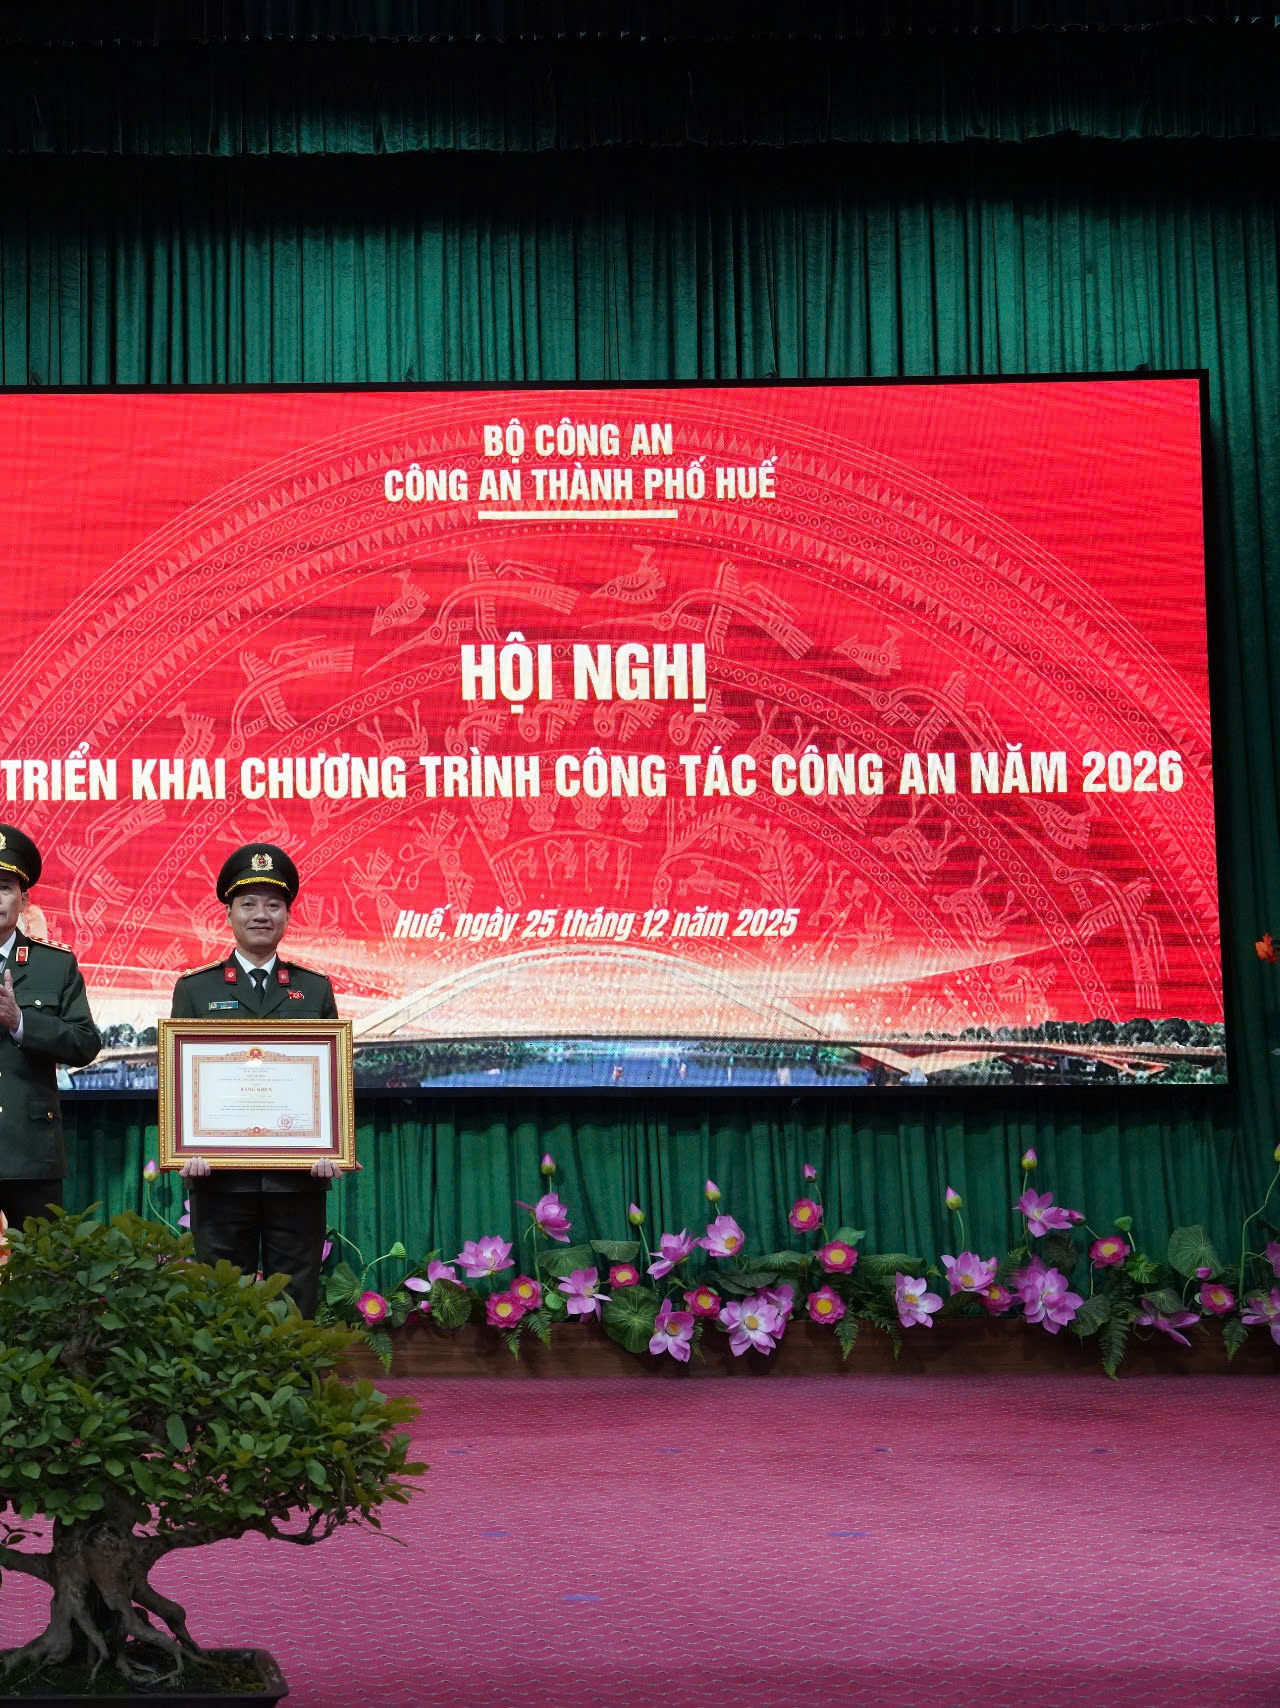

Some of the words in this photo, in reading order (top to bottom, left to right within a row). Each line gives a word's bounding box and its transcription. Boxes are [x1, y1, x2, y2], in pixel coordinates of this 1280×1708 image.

[483, 418, 524, 463] BỘ
[534, 417, 620, 457] CÔNG
[629, 423, 673, 456] AN
[384, 463, 469, 501] CÔNG
[478, 469, 522, 501] AN
[531, 462, 634, 500] THÀNH
[643, 456, 706, 500] PHỐ
[715, 455, 778, 499] HUẾ
[461, 631, 553, 714] HỘI
[573, 642, 707, 713] NGHỊ
[0, 741, 117, 801] TRIỂN
[131, 757, 226, 801] KHAI
[240, 752, 407, 800] CHƯƠNG
[420, 746, 541, 798] TRÌNH
[554, 746, 667, 798] CÔNG
[679, 745, 757, 797] TÁC
[771, 744, 884, 797] CÔNG
[899, 752, 956, 795] AN
[970, 743, 1068, 795] NĂM
[1082, 750, 1184, 793] 2026
[393, 904, 452, 941] Huế,
[453, 908, 518, 942] ngày
[521, 908, 558, 938] 25
[561, 905, 636, 942] tháng
[642, 909, 671, 937] 12
[670, 905, 730, 937] năm
[732, 908, 801, 938] 2025
